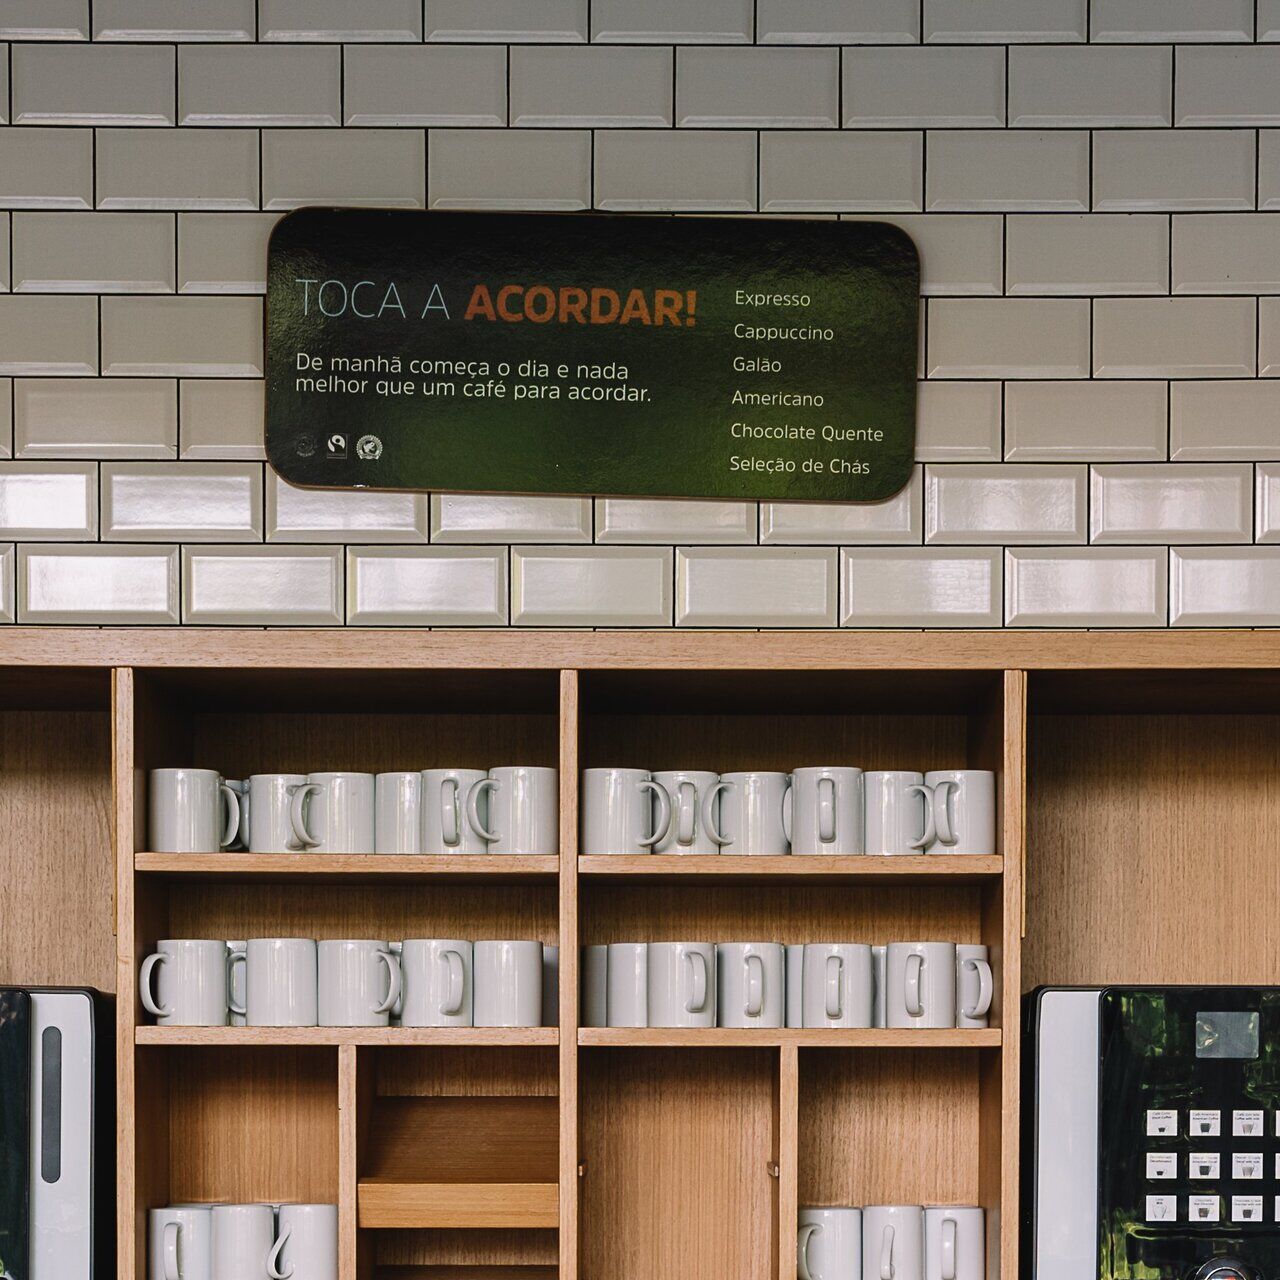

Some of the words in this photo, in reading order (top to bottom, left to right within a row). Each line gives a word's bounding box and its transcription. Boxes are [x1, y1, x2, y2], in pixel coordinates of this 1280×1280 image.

[295, 279, 406, 319] TOCA
[421, 284, 450, 320] A
[464, 285, 697, 327] ACORDAR!
[735, 290, 811, 307] Expresso
[733, 324, 834, 341] Cappuccino
[296, 353, 323, 371] De
[331, 354, 402, 374] manhã
[409, 360, 490, 379] começa
[497, 363, 510, 376] o
[517, 361, 549, 378] dia
[556, 365, 569, 379] e
[577, 361, 629, 380] nada
[732, 356, 782, 373] Galão
[295, 374, 368, 395] melhor
[376, 380, 415, 397] que
[422, 382, 455, 396] um
[462, 379, 507, 398] café
[514, 384, 561, 401] para
[568, 383, 651, 402] acordar.
[731, 390, 824, 407] Americano
[730, 423, 816, 441] Chocolate
[821, 425, 884, 442] Quente
[729, 456, 796, 475] Seleção
[801, 457, 824, 473] de
[829, 457, 870, 475] Chás
